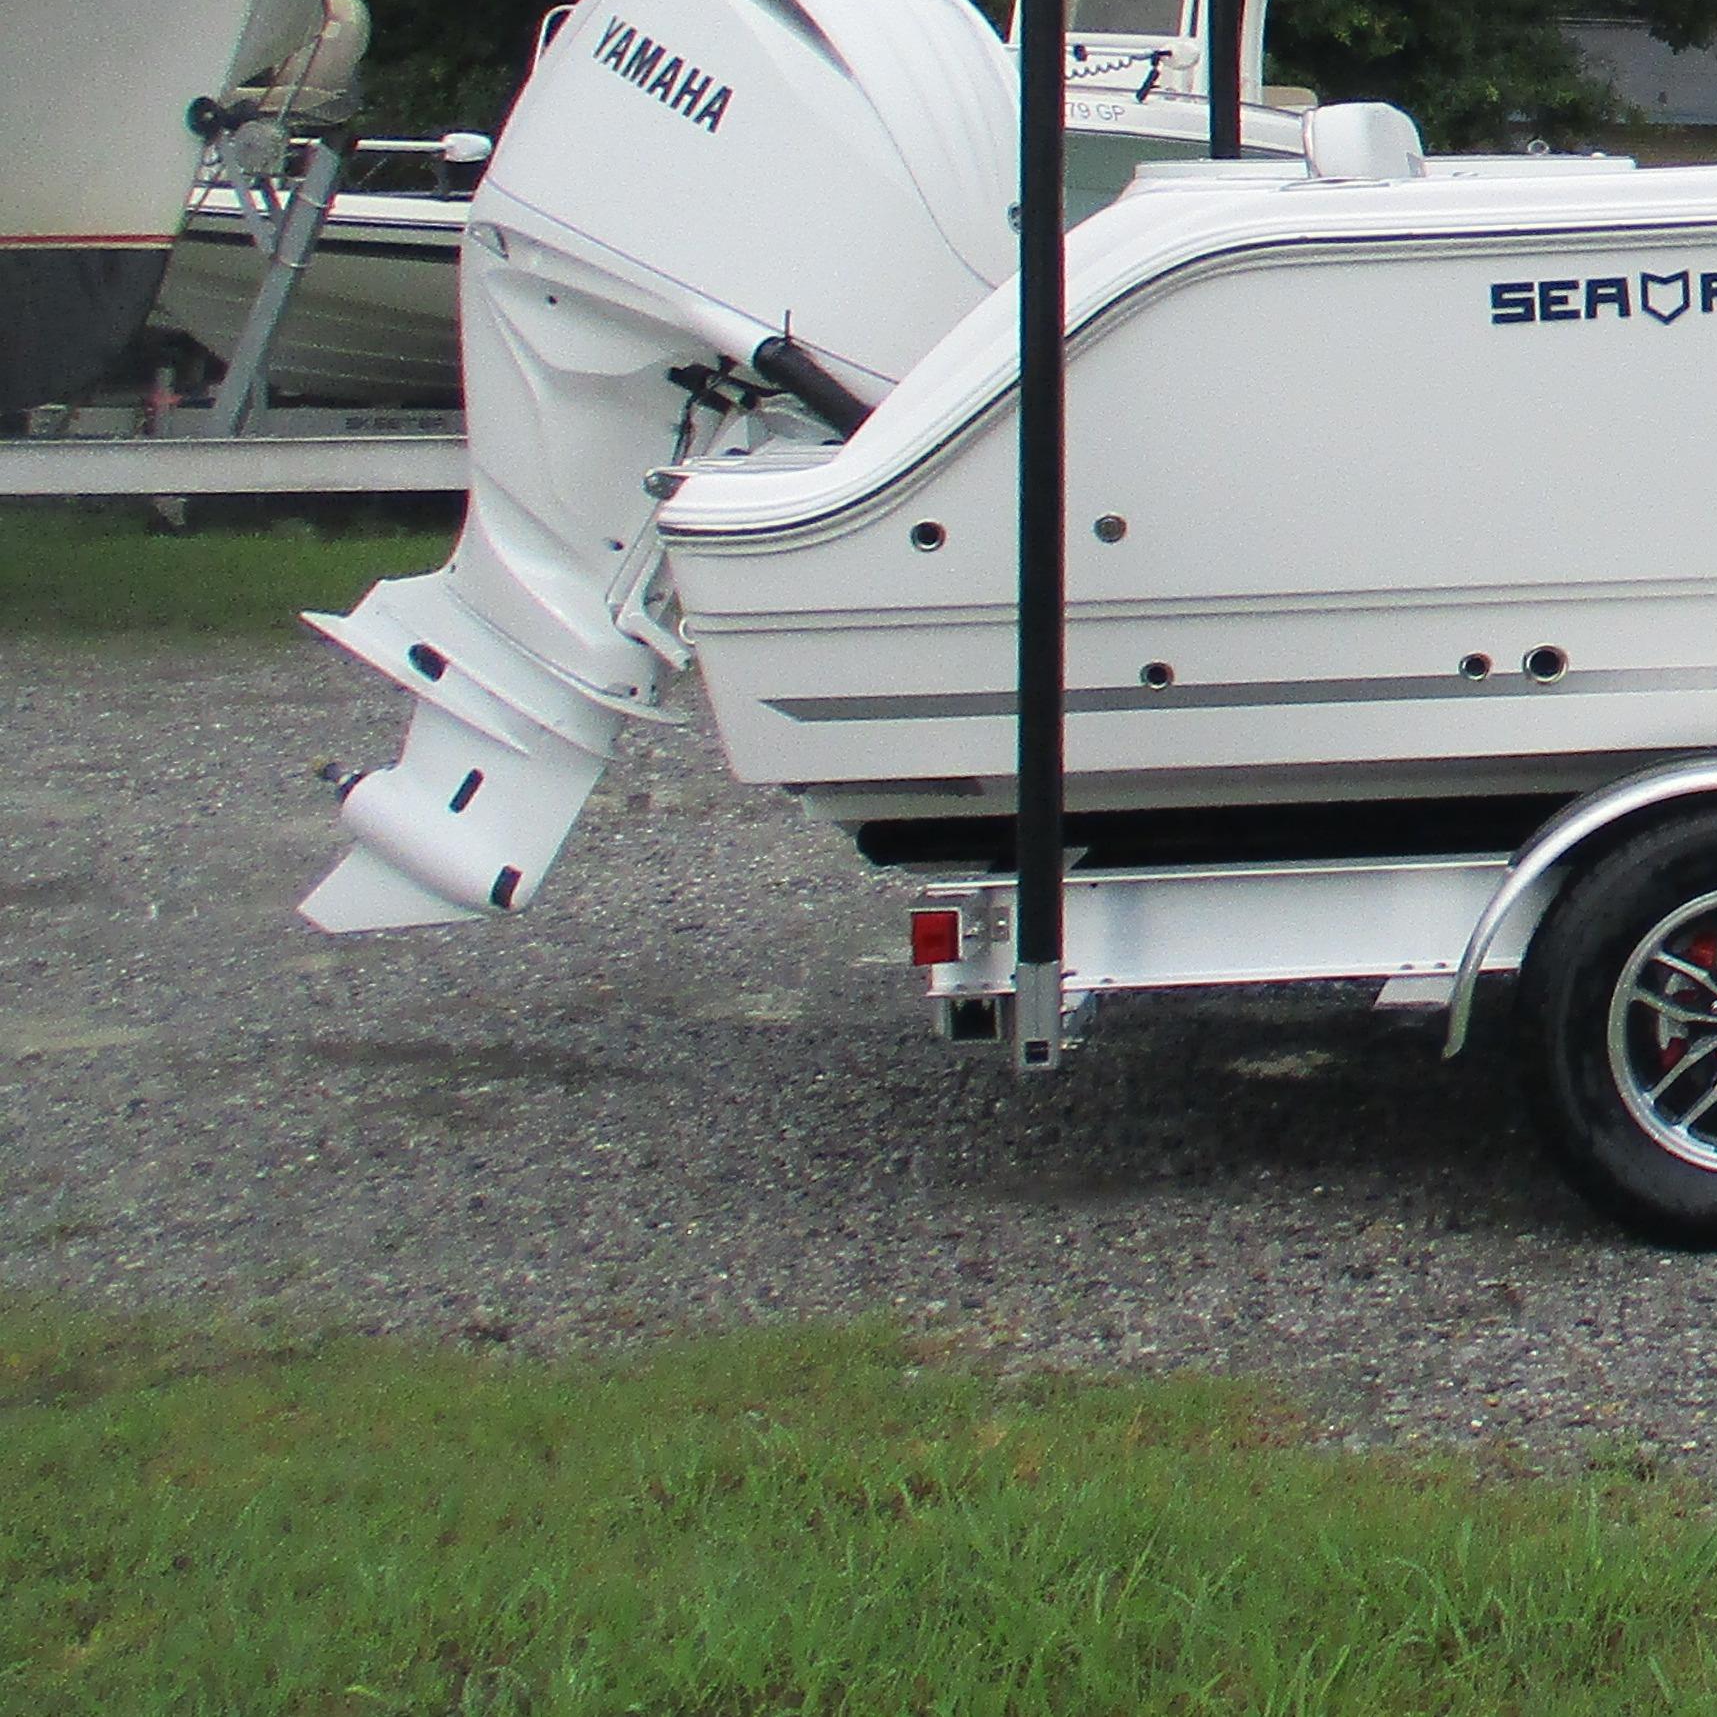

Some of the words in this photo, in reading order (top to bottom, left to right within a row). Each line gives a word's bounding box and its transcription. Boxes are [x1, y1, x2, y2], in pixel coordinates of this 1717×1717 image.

[593, 14, 734, 133] YAMAHA
[1065, 101, 1091, 120] 79
[1096, 103, 1126, 121] GP
[1490, 276, 1631, 324] SEA
